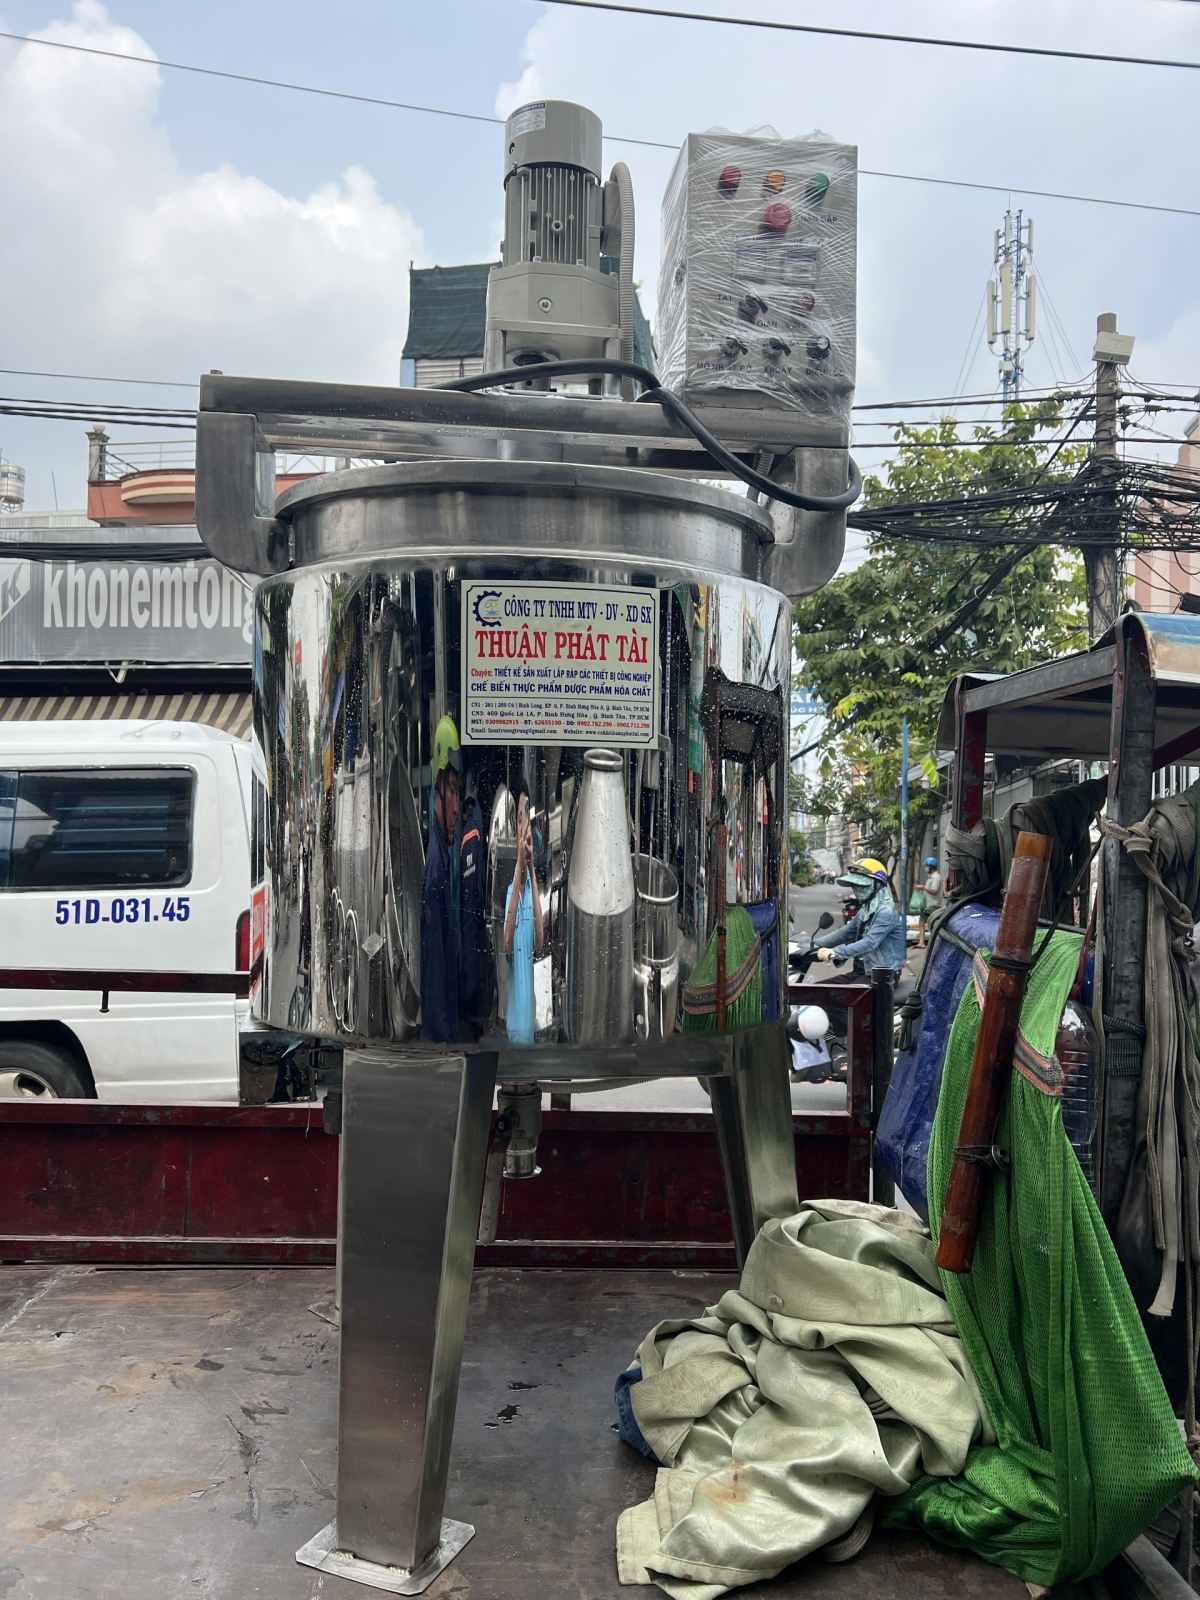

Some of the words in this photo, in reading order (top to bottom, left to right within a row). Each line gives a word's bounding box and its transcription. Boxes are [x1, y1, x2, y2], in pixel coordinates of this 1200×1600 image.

[712, 363, 737, 372] NHT
[504, 594, 530, 617] CÔNG
[533, 600, 546, 617] TY
[548, 600, 575, 618] TNHH
[577, 601, 598, 619] MTV
[606, 603, 619, 621] DV
[626, 605, 639, 623] XD
[641, 606, 652, 624] SX
[475, 622, 548, 665] THUẬN
[554, 624, 610, 661] PHÁT
[615, 627, 648, 663] TÀI
[471, 668, 493, 678] Chuyên:
[494, 665, 511, 677] THIẾT
[513, 665, 522, 677] KẾ
[523, 666, 535, 678] SẢN
[536, 666, 552, 678] XUẤT
[553, 666, 565, 678] LẮP
[566, 668, 578, 679] RÁP
[580, 668, 591, 679] CÁC
[592, 668, 608, 680] THIẾT
[610, 671, 616, 682] BỊ
[617, 670, 632, 682] CÔNG
[633, 671, 651, 683] NGHIỆP
[471, 680, 488, 692] CHẾ
[490, 680, 510, 692] BIẾN
[513, 682, 535, 694] THỰC
[538, 680, 562, 693] PHẨM
[564, 683, 587, 695] DƯỢC
[589, 682, 612, 695] PHẨM
[614, 685, 630, 696] HÓA
[632, 684, 651, 696] CHẤT
[55, 896, 191, 925] 51D-031.45
